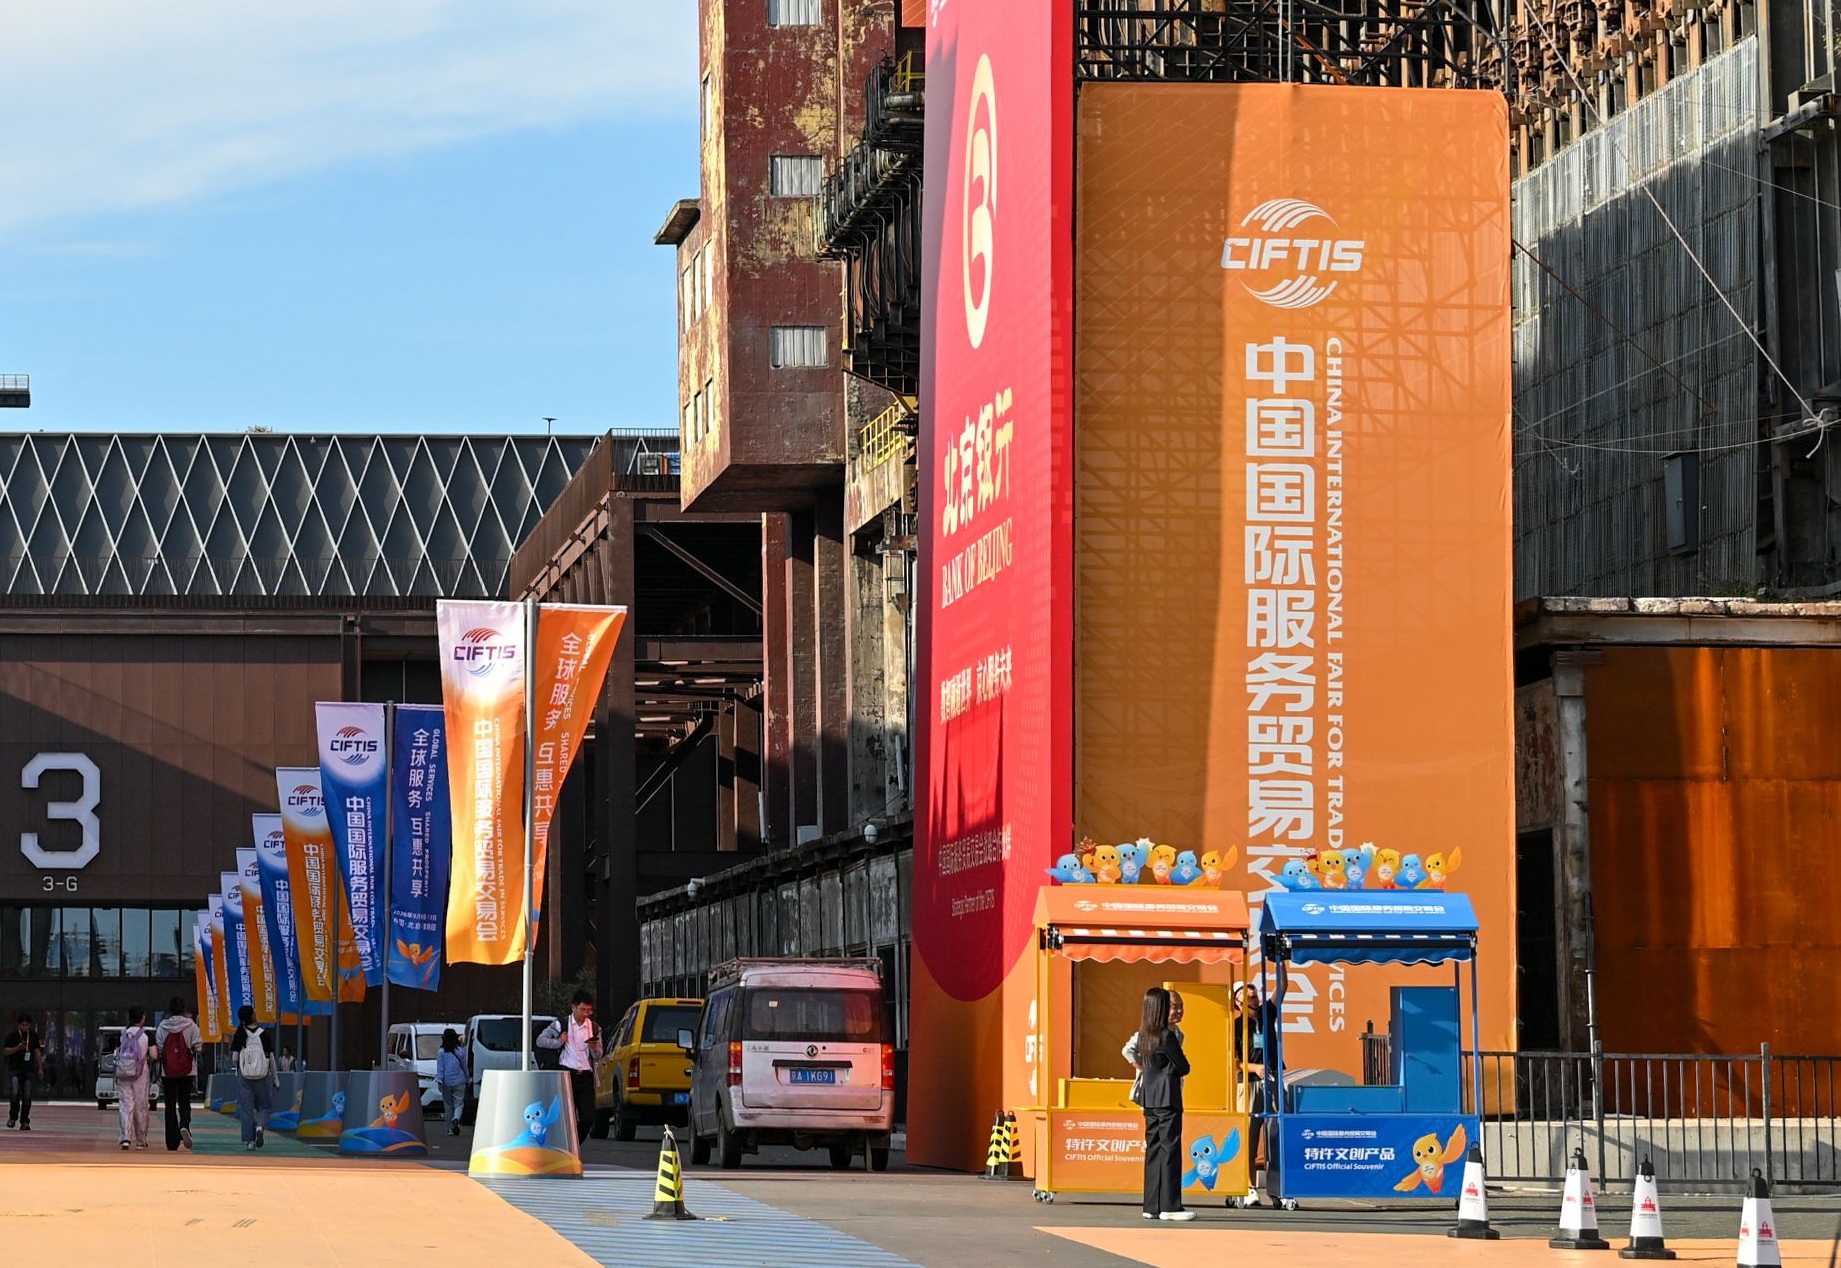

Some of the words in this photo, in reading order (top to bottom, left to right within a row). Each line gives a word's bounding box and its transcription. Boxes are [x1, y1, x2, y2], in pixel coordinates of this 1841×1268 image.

[1221, 237, 1365, 272] CIFTIS
[1326, 336, 1343, 426] CHINA
[1326, 431, 1344, 645] INTERNATIONAL
[941, 551, 964, 610] BANK
[964, 546, 976, 594] OF
[976, 517, 1014, 585] BEIJING
[453, 644, 516, 662] CIFTIS
[543, 632, 583, 732] 全球服务
[1327, 651, 1344, 708] FAIR
[330, 739, 378, 752] CIFTIS
[429, 728, 441, 760] GLOBAL
[494, 717, 502, 747] CHINA
[559, 731, 571, 774] SHARED
[1327, 714, 1344, 770] FOR
[407, 728, 430, 809] 全球服务
[425, 763, 437, 802] SERVICES
[495, 747, 503, 818] INTERNATIONAL
[20, 751, 101, 870] 3
[1327, 774, 1344, 849] TRAD
[263, 839, 285, 849] CIFT
[367, 820, 375, 875] INTERNATIONAL
[409, 817, 425, 899] 互惠共享
[43, 876, 78, 892] 3-G
[497, 858, 505, 887] TRADE
[499, 888, 506, 899] IN
[499, 900, 507, 941] SERVICES
[1087, 1154, 1113, 1162] Official
[1304, 1147, 1395, 1161] 特许文创产品
[1304, 1162, 1326, 1170] CIFTIS
[1327, 1162, 1353, 1170] Official
[1353, 1162, 1384, 1170] Souvenir
